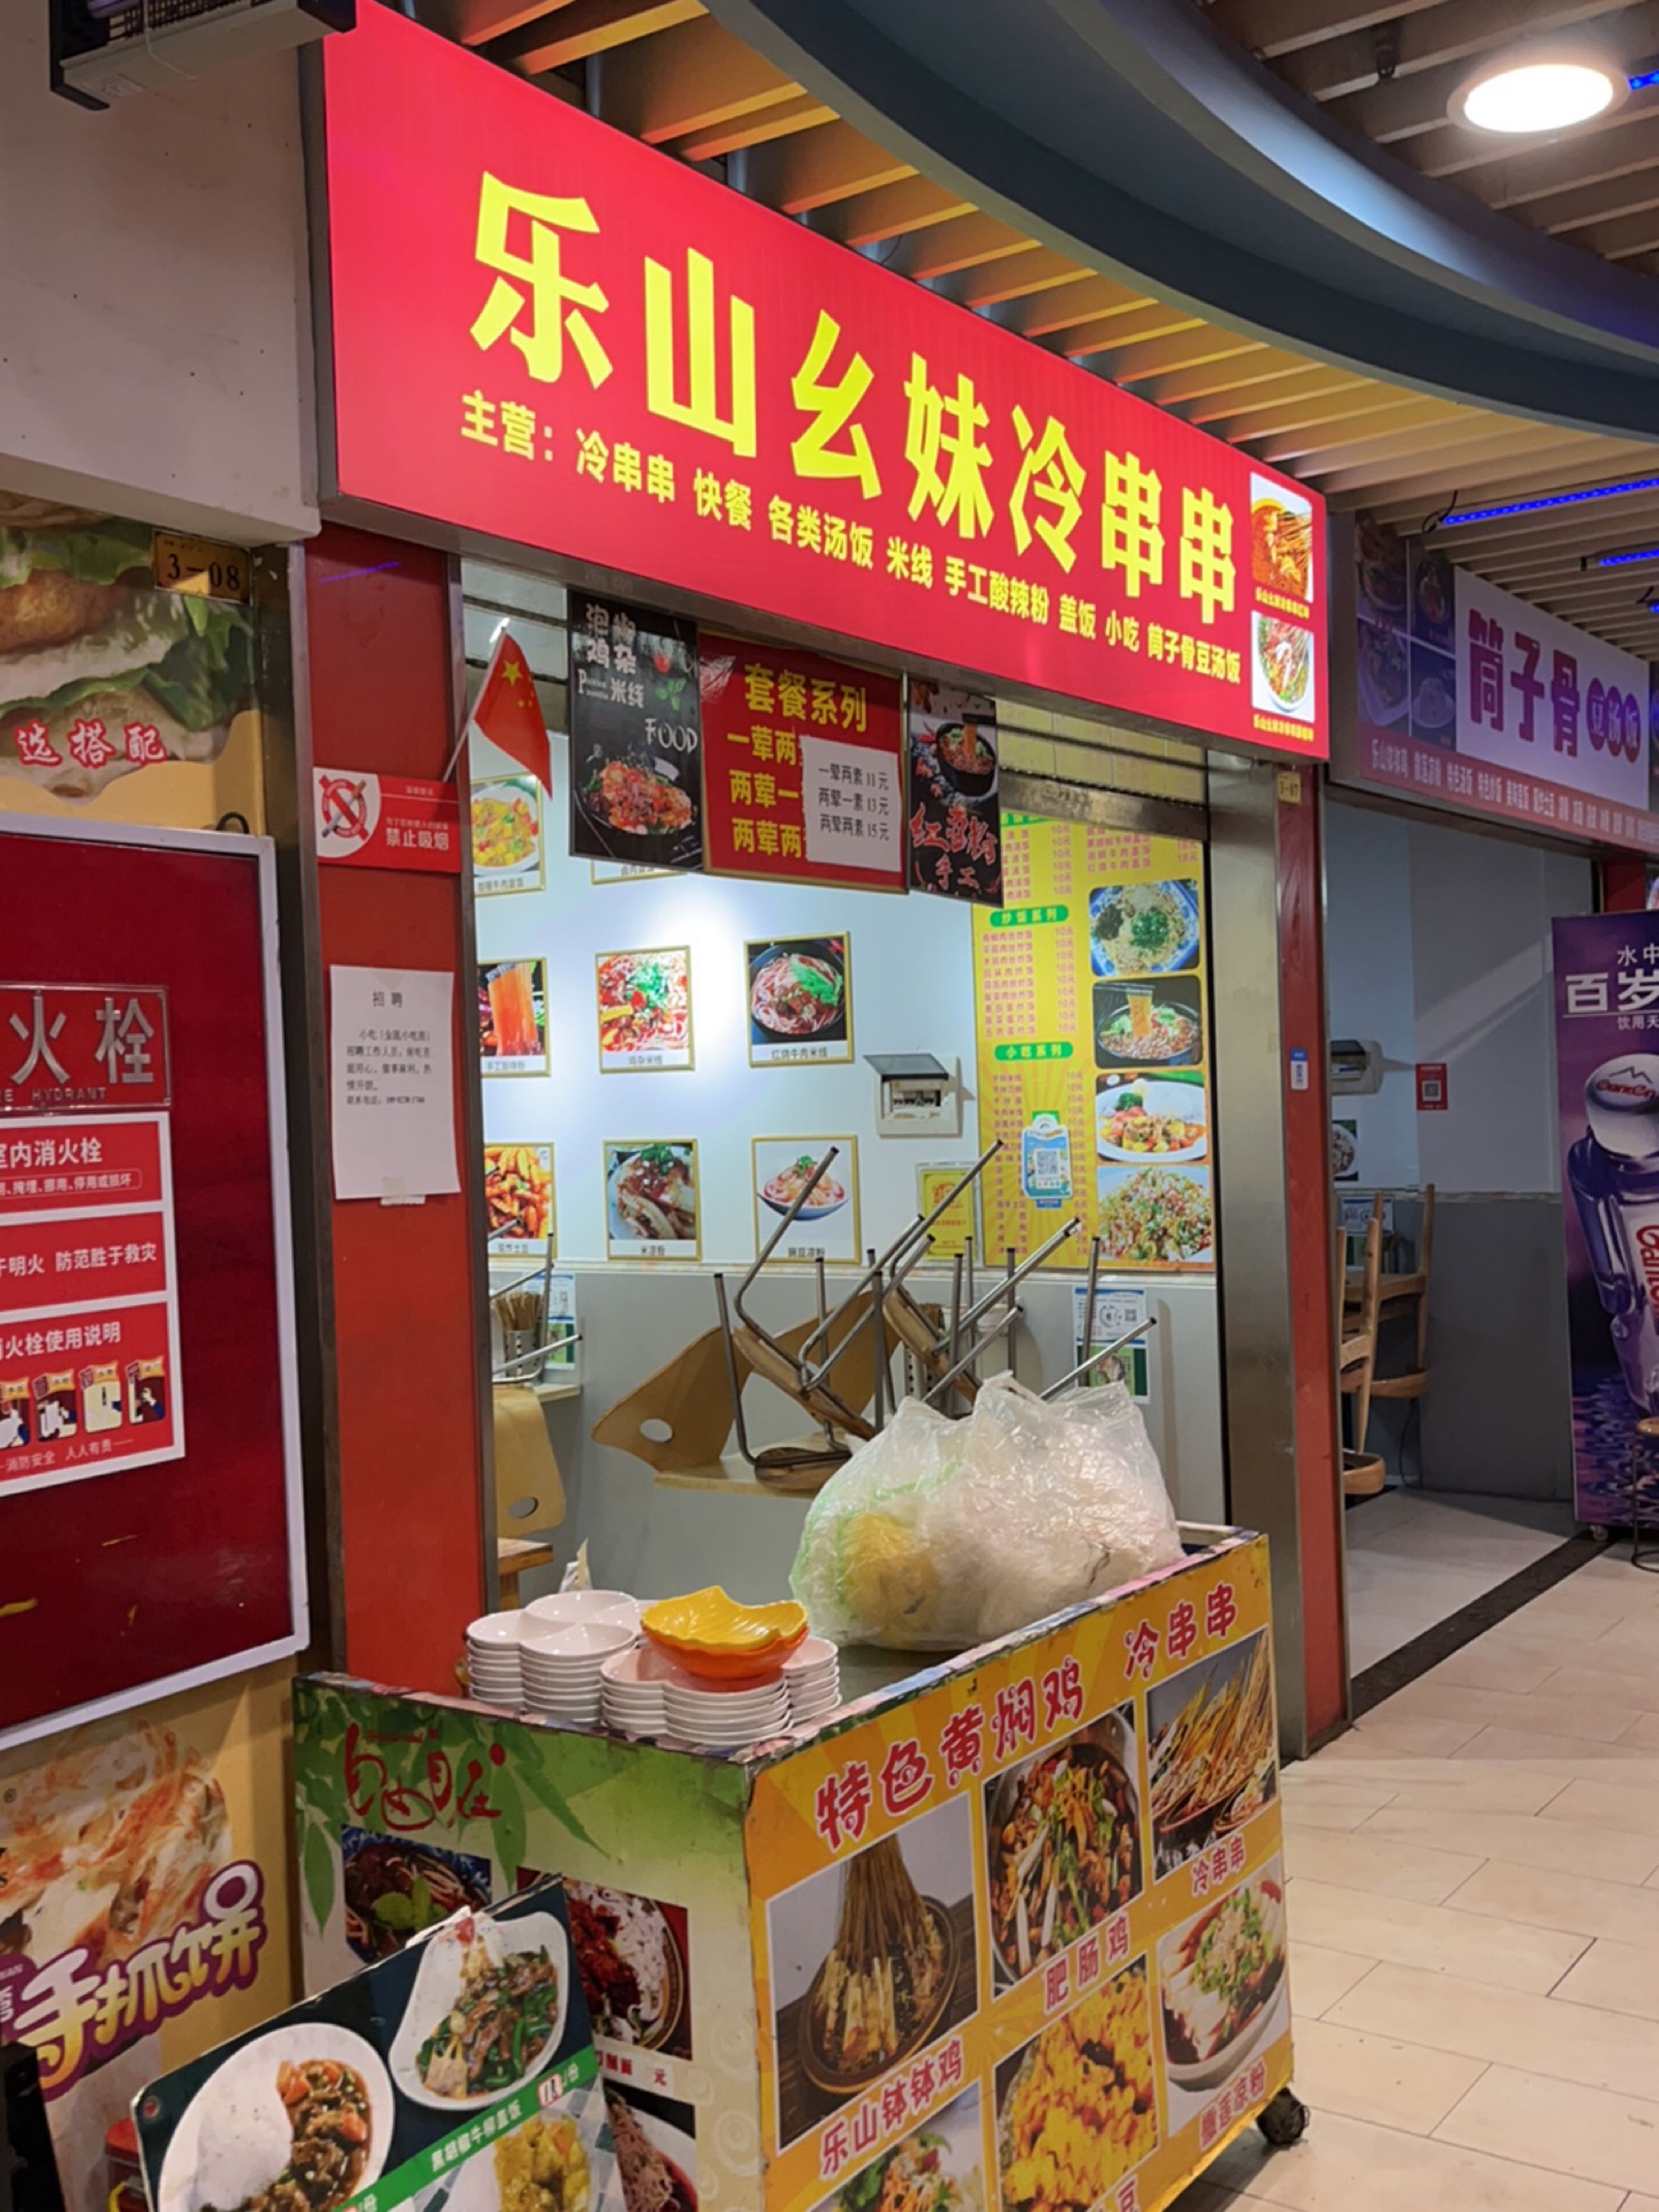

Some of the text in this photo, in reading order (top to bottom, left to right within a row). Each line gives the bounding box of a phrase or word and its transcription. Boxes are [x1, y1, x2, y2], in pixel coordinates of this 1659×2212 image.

[470, 171, 1236, 623] 乐山幺妹冷串串
[576, 428, 675, 503] 冷串串
[694, 469, 752, 531] 快餐
[769, 496, 874, 569] 各类汤饭
[886, 536, 933, 589] 米线
[945, 556, 1049, 624] 手工酸辣粉
[1059, 593, 1097, 641] 盖饭
[1105, 610, 1140, 653] 小吃
[1148, 623, 1241, 685] 筒子骨豆汤饭
[744, 662, 867, 733] 套餐系列
[1468, 609, 1580, 758] 筒子骨
[727, 725, 799, 766] 一荤两
[386, 828, 449, 851] 禁止吸烟
[9, 995, 155, 1085] 火栓
[32, 1087, 106, 1102] HYDRANT
[56, 1242, 157, 1273] 防范胜于救灾
[816, 1582, 1237, 1852] 特色黄焖鸡 冷串串
[1192, 1834, 1246, 1896] 冷串串
[14, 1863, 259, 2089] 手抓饼
[1045, 1911, 1130, 2014] 肥肠鸡
[821, 2039, 963, 2179] 乐山钵钵鸡
